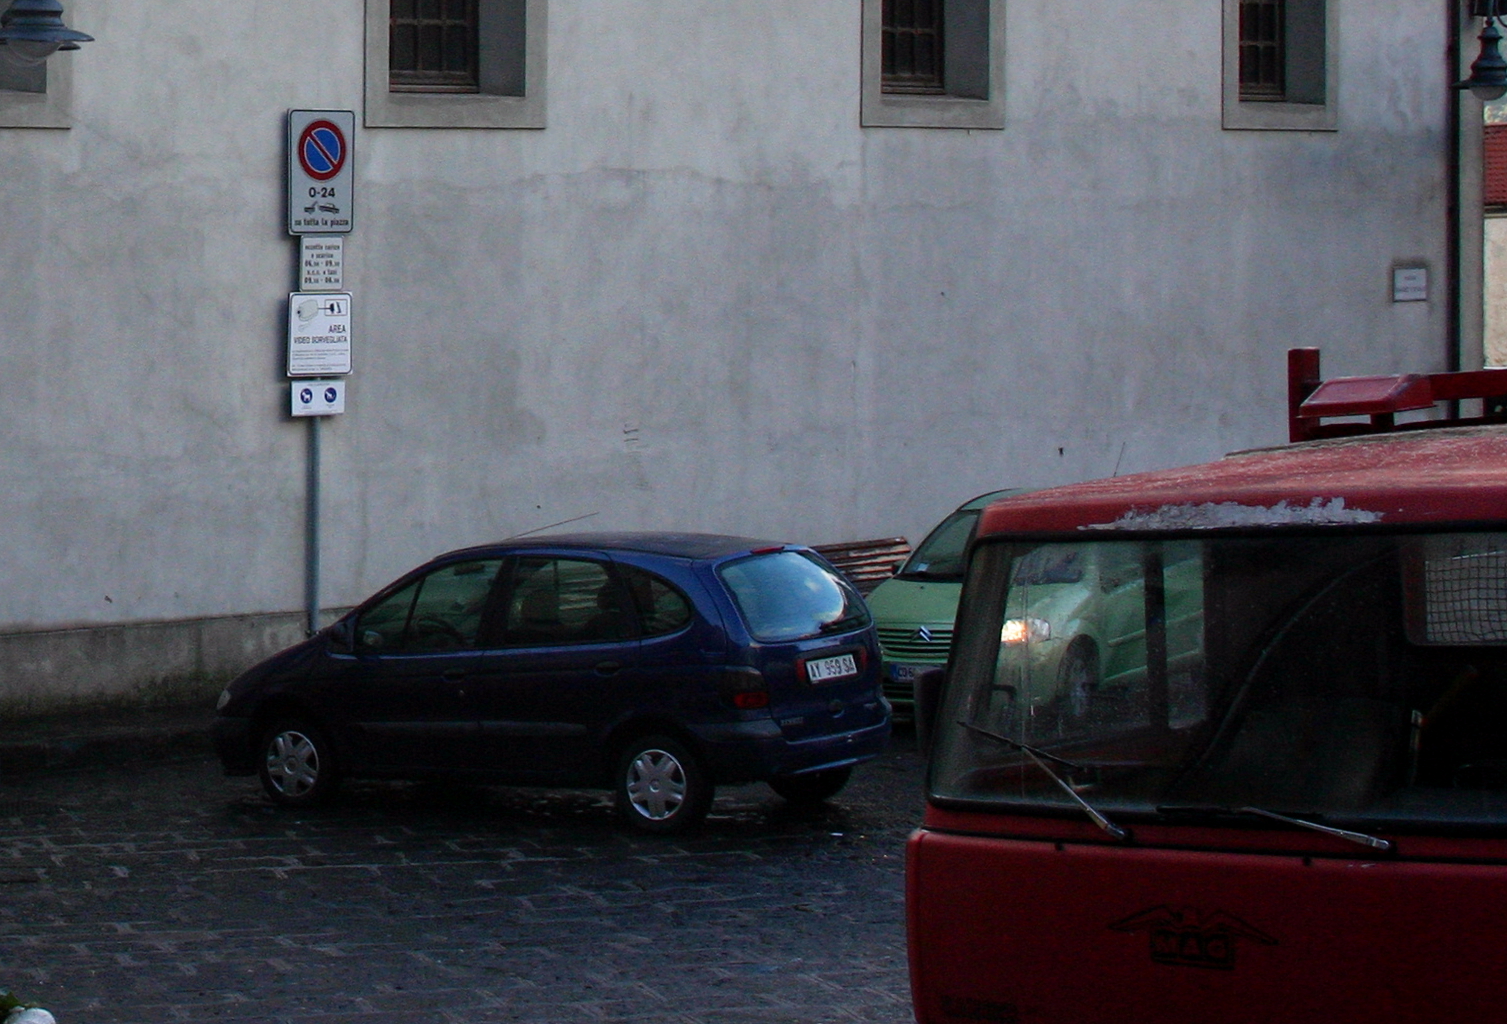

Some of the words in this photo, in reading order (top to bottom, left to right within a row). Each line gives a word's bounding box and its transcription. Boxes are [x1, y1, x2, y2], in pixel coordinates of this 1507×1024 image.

[308, 187, 336, 198] 0-24
[321, 218, 328, 226] la
[330, 218, 349, 228] piazza
[328, 324, 346, 333] AREA
[810, 662, 822, 678] AY
